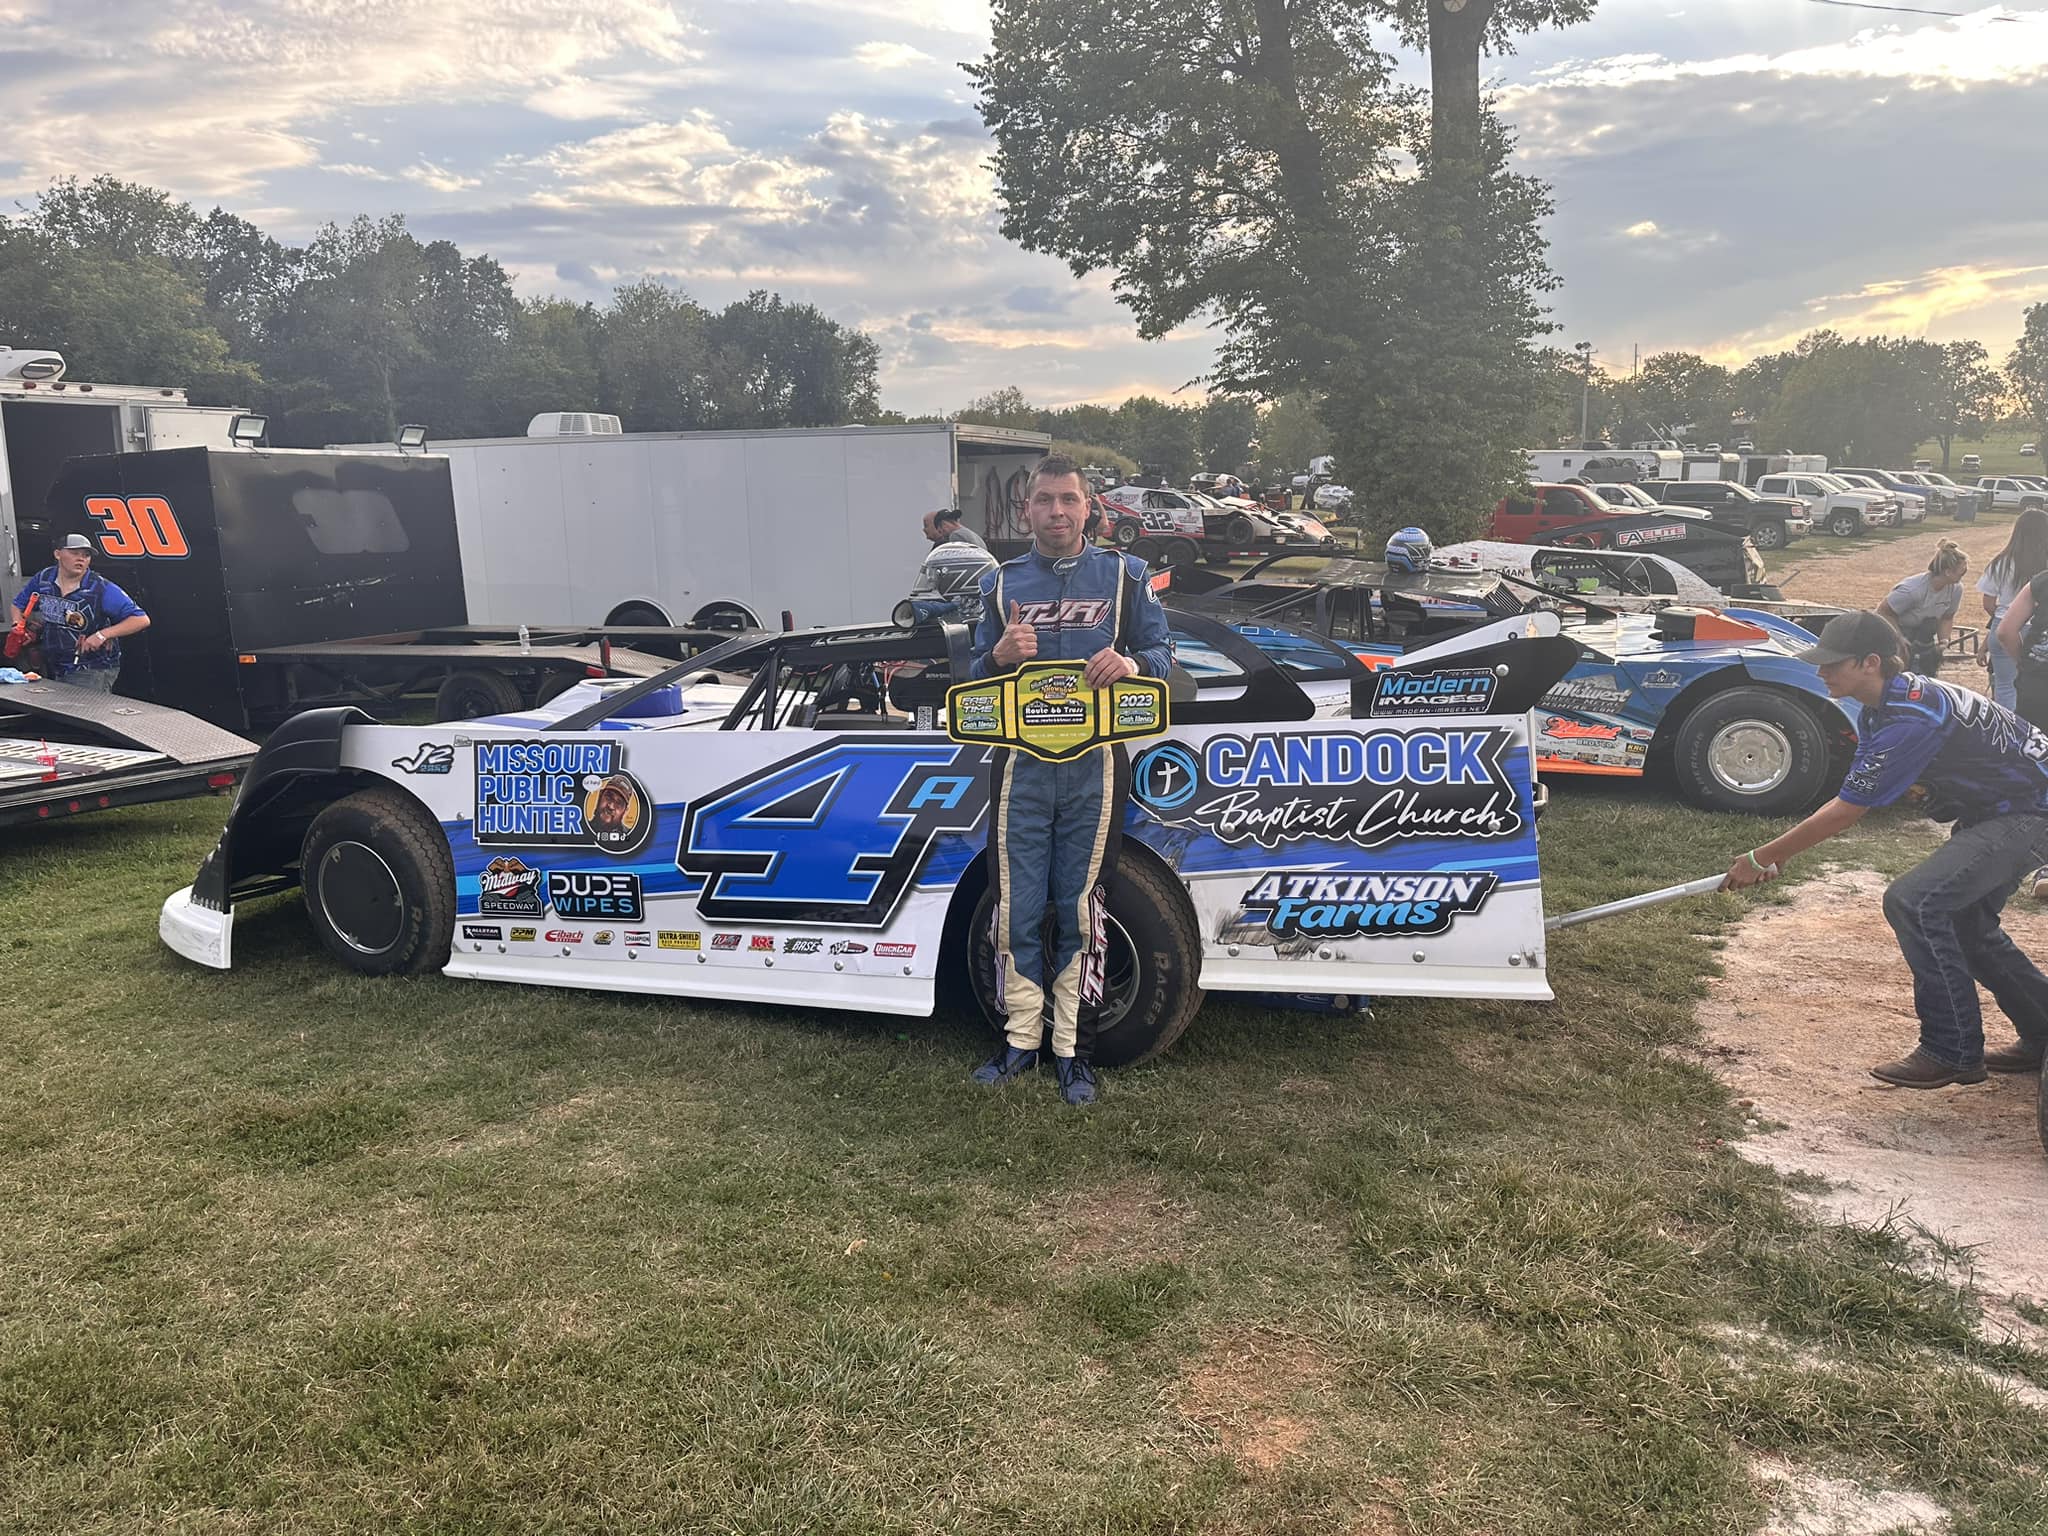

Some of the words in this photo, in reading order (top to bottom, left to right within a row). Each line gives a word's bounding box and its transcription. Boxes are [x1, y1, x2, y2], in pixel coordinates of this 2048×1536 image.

[85, 495, 189, 558] 30
[1141, 512, 1175, 530] 32
[1642, 527, 1685, 539] ELITE
[1381, 676, 1490, 696] Modern
[1546, 681, 1632, 702] Midwest
[963, 705, 993, 713] TIME
[1120, 695, 1153, 706] 2023
[1379, 694, 1486, 706] IMAGES
[478, 744, 611, 773] MISSOURI
[1207, 731, 1494, 787] CANDOCK
[478, 775, 574, 804] PUBLIC
[478, 805, 583, 835] HUNTER
[1196, 790, 1347, 838] Baptist
[1355, 791, 1505, 838] Church
[482, 871, 536, 892] Midway
[552, 875, 632, 896] DUDE
[1249, 874, 1484, 902] ATKINSON
[483, 902, 535, 911] SPEEDWAY
[554, 898, 634, 912] WIPES
[1273, 898, 1440, 930] Farms
[546, 930, 584, 941] Eibach
[792, 941, 818, 952] BASE
[1144, 951, 1169, 1024] RACER
